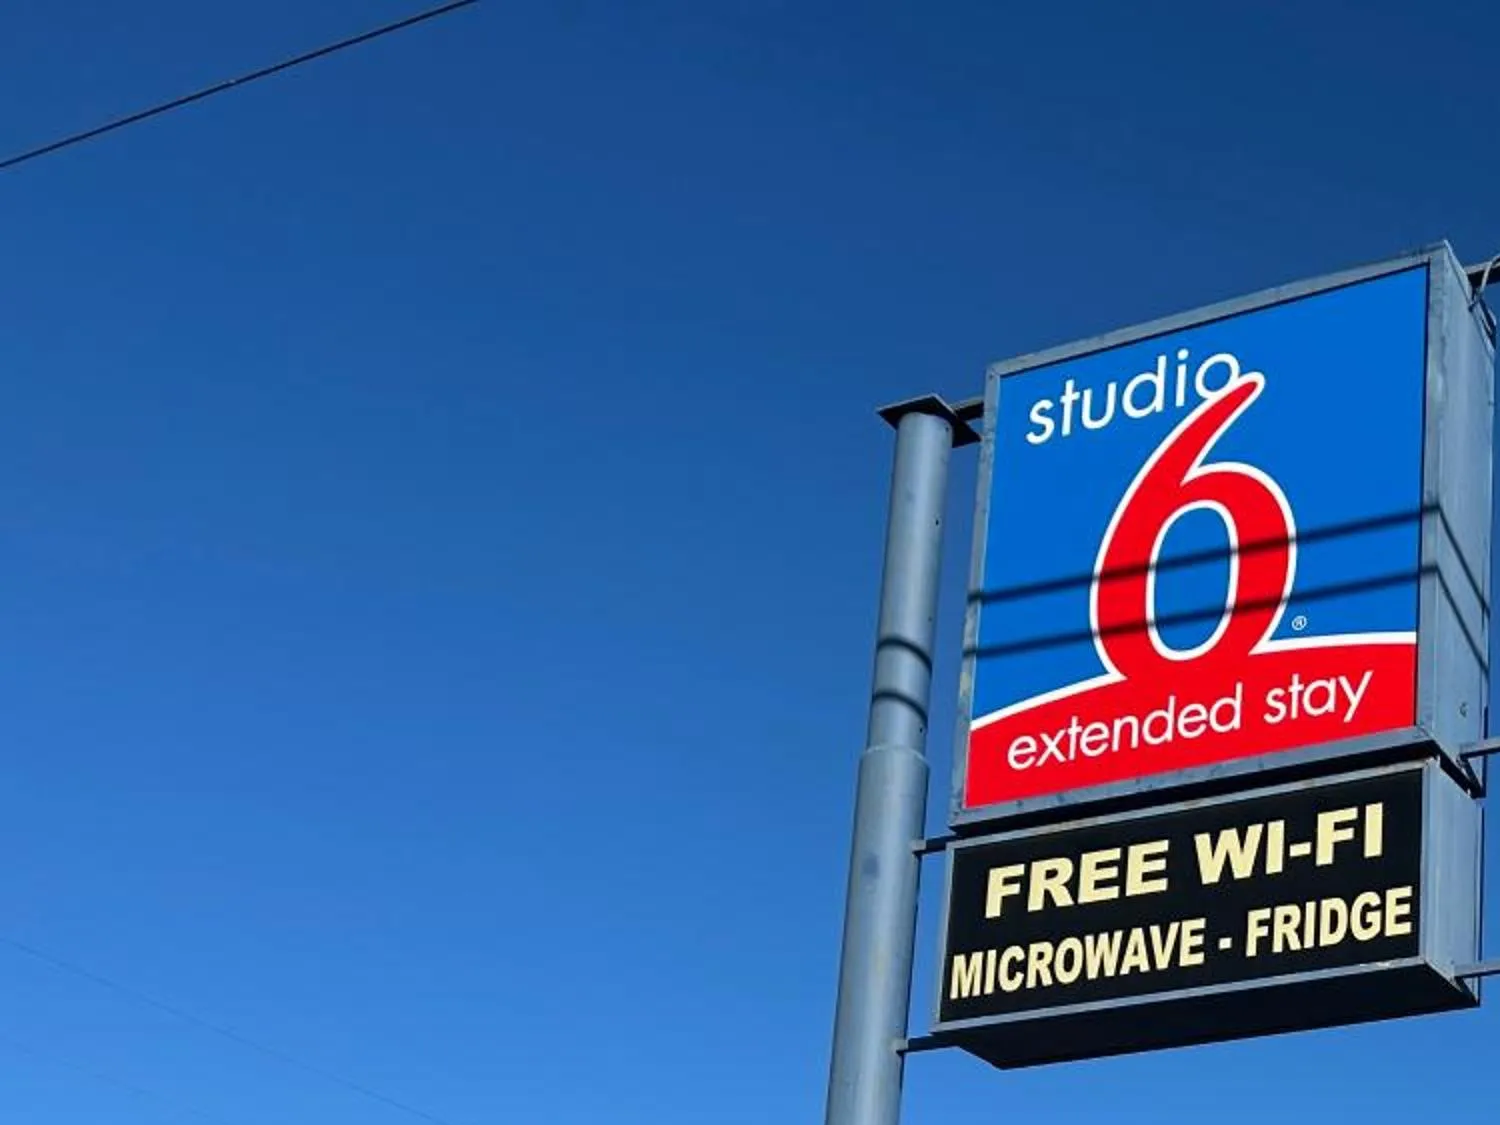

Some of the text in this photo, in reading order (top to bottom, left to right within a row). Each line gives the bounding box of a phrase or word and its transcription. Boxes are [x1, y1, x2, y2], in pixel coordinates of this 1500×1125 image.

[1025, 349, 1241, 444] studio
[1090, 371, 1297, 680] 6
[1007, 670, 1373, 771] extended stay
[985, 802, 1384, 919] FREE WI-FI
[949, 918, 1205, 1000] MICROWAVE
[1246, 886, 1413, 957] FRIDGE
